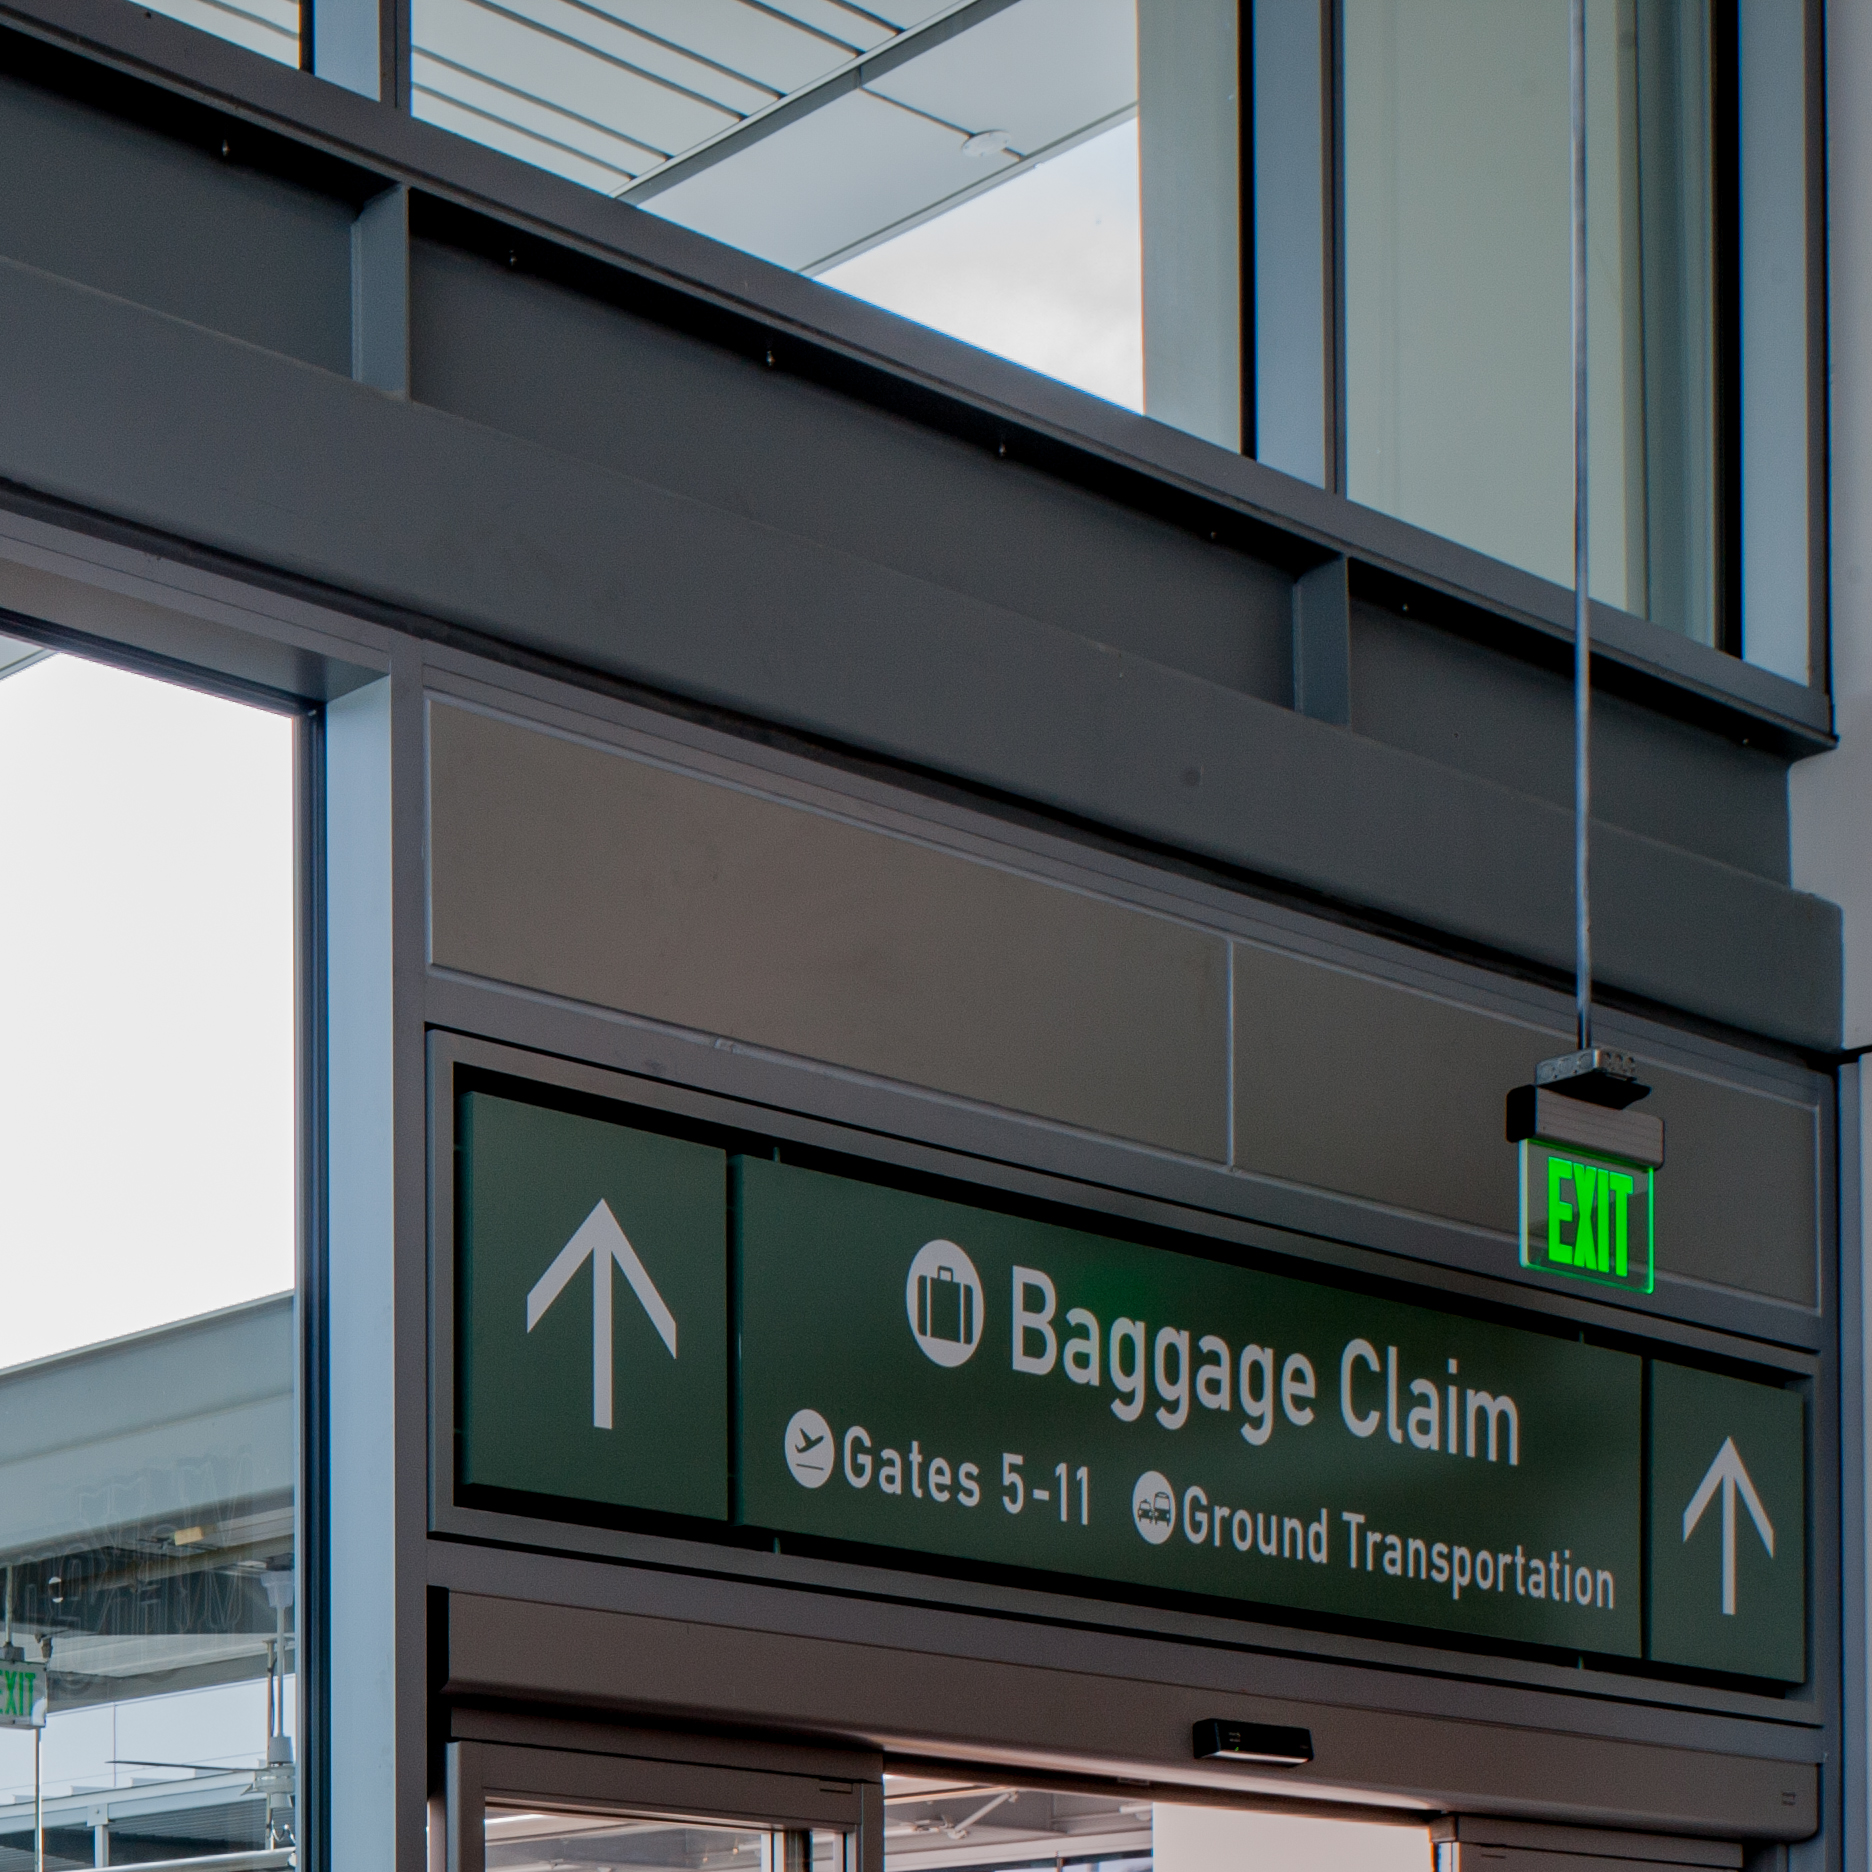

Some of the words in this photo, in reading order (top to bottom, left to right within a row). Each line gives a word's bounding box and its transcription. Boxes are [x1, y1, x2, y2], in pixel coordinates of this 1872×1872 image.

[1548, 1156, 1634, 1278] EXIT
[1011, 1266, 1316, 1446] Baggage
[1341, 1339, 1518, 1466] Claim
[844, 1426, 980, 1507] Gates
[1003, 1453, 1088, 1525] 5-11
[1183, 1485, 1327, 1564] Ground
[1343, 1512, 1614, 1609] Transportation
